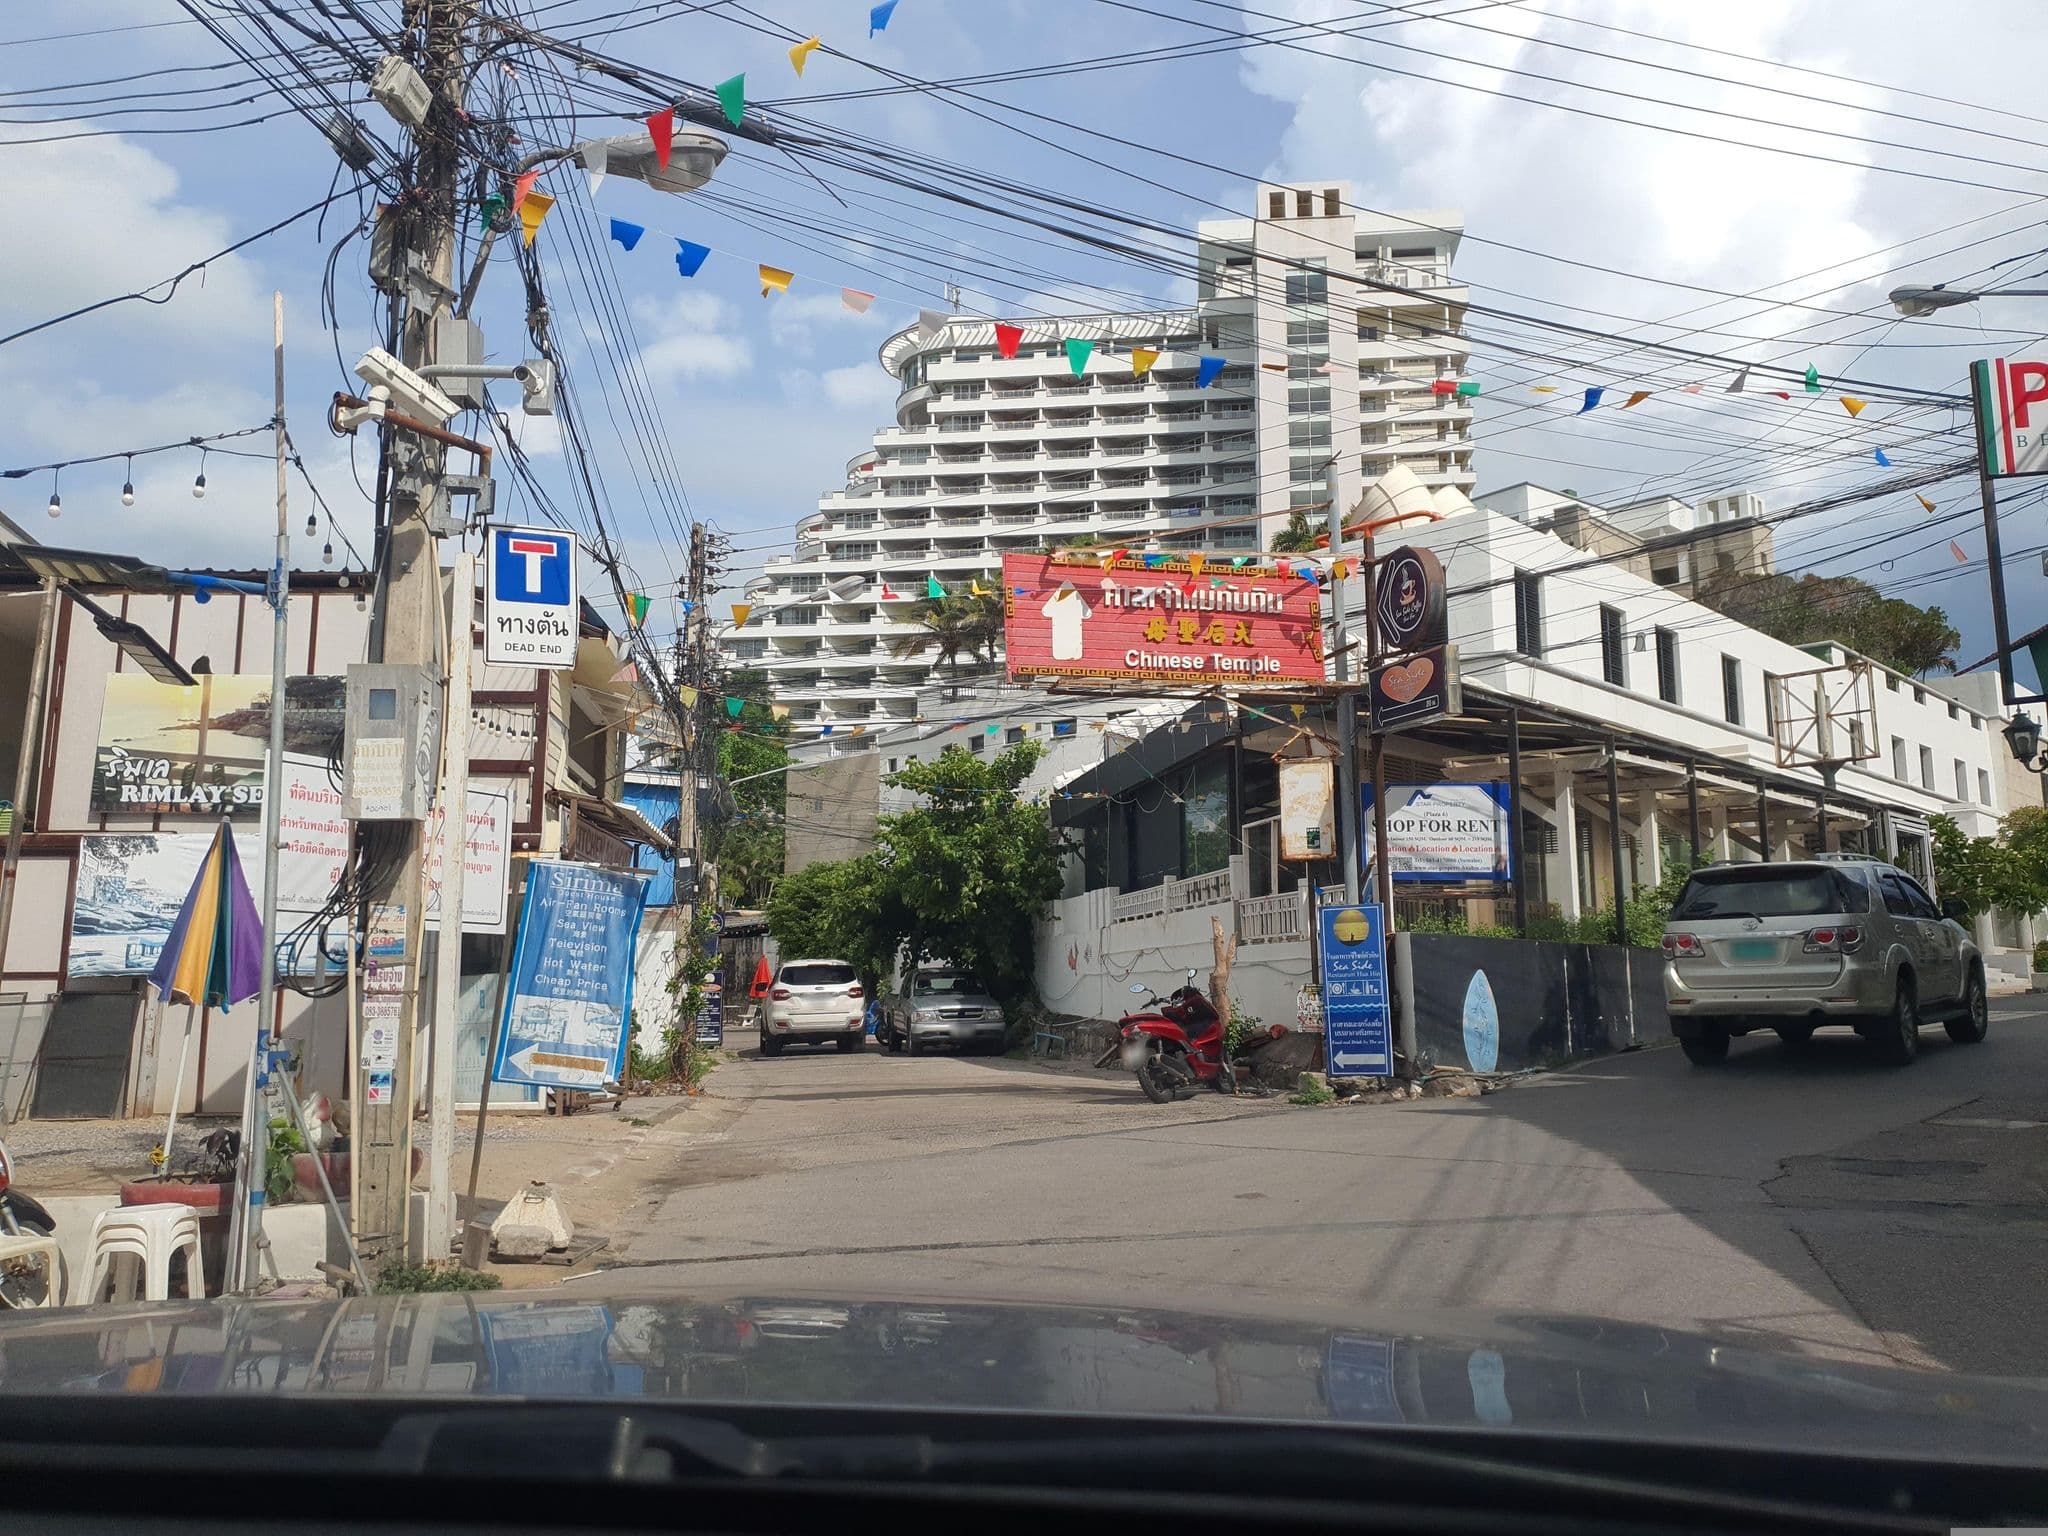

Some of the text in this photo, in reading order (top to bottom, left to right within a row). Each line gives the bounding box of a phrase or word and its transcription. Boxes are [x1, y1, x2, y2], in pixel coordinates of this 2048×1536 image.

[2008, 361, 2048, 429] P
[2016, 433, 2048, 448] BE
[497, 610, 569, 637] ทางตัน
[504, 642, 562, 653] DEAD END
[1125, 649, 1281, 675] Chinese Temple
[105, 745, 171, 779] ริมเล
[119, 784, 264, 804] RIMLAY SE
[289, 778, 342, 806] ที่ดินบริเว
[280, 815, 348, 835] สำหรับพลเมืองใ
[1419, 819, 1452, 833] FOR
[1457, 819, 1501, 833] RENT
[287, 839, 347, 858] หรือยึดถือครอ
[1373, 845, 1493, 853] Lation Location Location
[464, 861, 492, 876] อนุญาต
[551, 871, 623, 894] Sirima
[558, 889, 616, 901] Guest House
[594, 904, 627, 918] Rooms
[556, 919, 607, 933] Sea View
[549, 937, 608, 953] Television
[543, 956, 606, 972] Hot Water
[1333, 960, 1374, 971] Sea Side
[534, 974, 609, 991] Cheap Price
